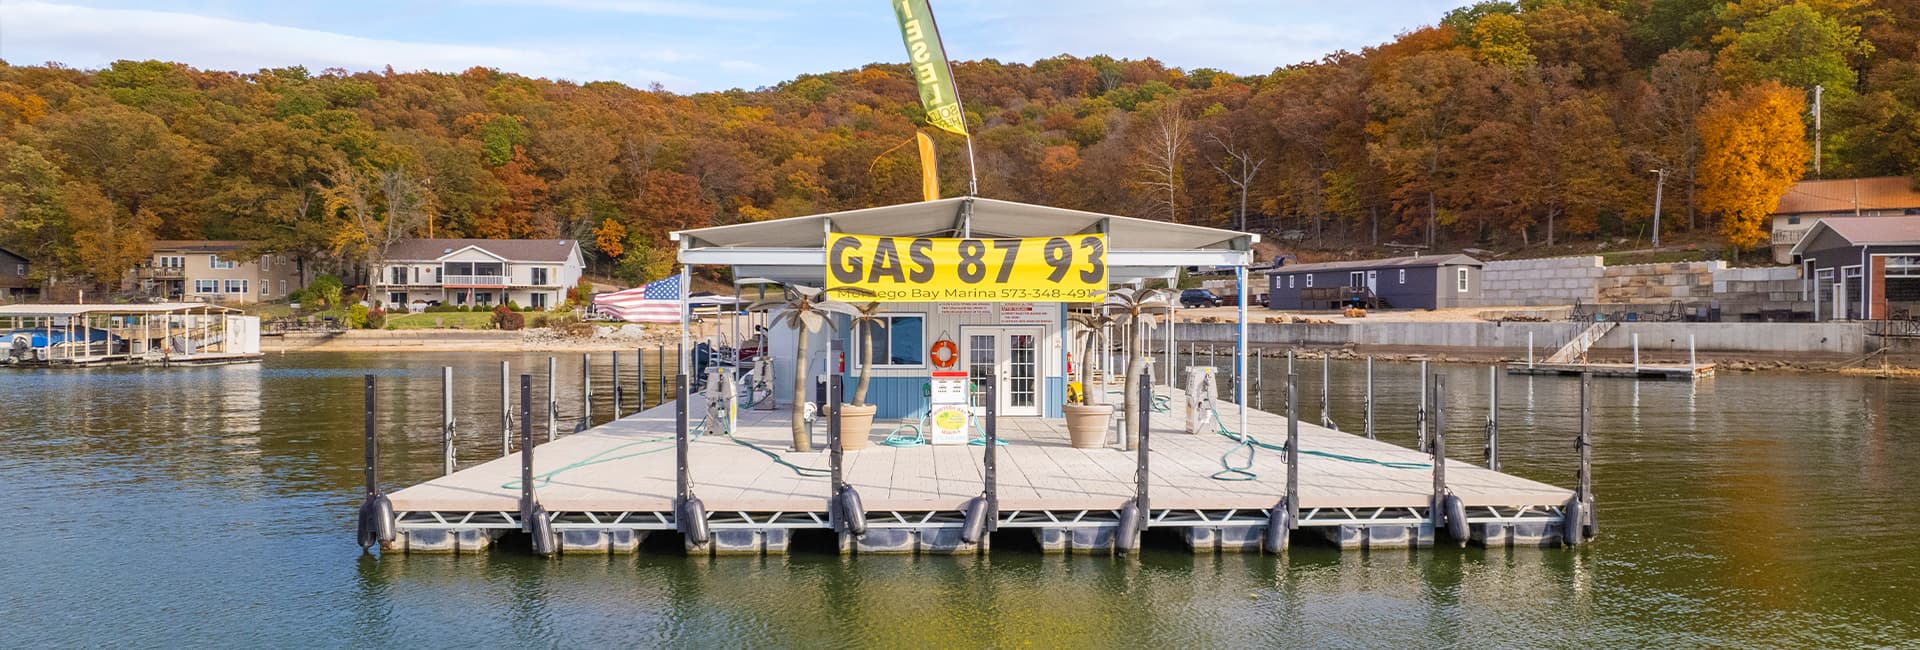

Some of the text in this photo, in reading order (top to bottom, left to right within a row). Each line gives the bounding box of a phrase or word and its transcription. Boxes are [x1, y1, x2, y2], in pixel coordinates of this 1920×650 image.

[830, 236, 1104, 284] GAS 87 93
[838, 289, 907, 300] Mego
[911, 288, 940, 300] Bay
[945, 288, 996, 298] Marina
